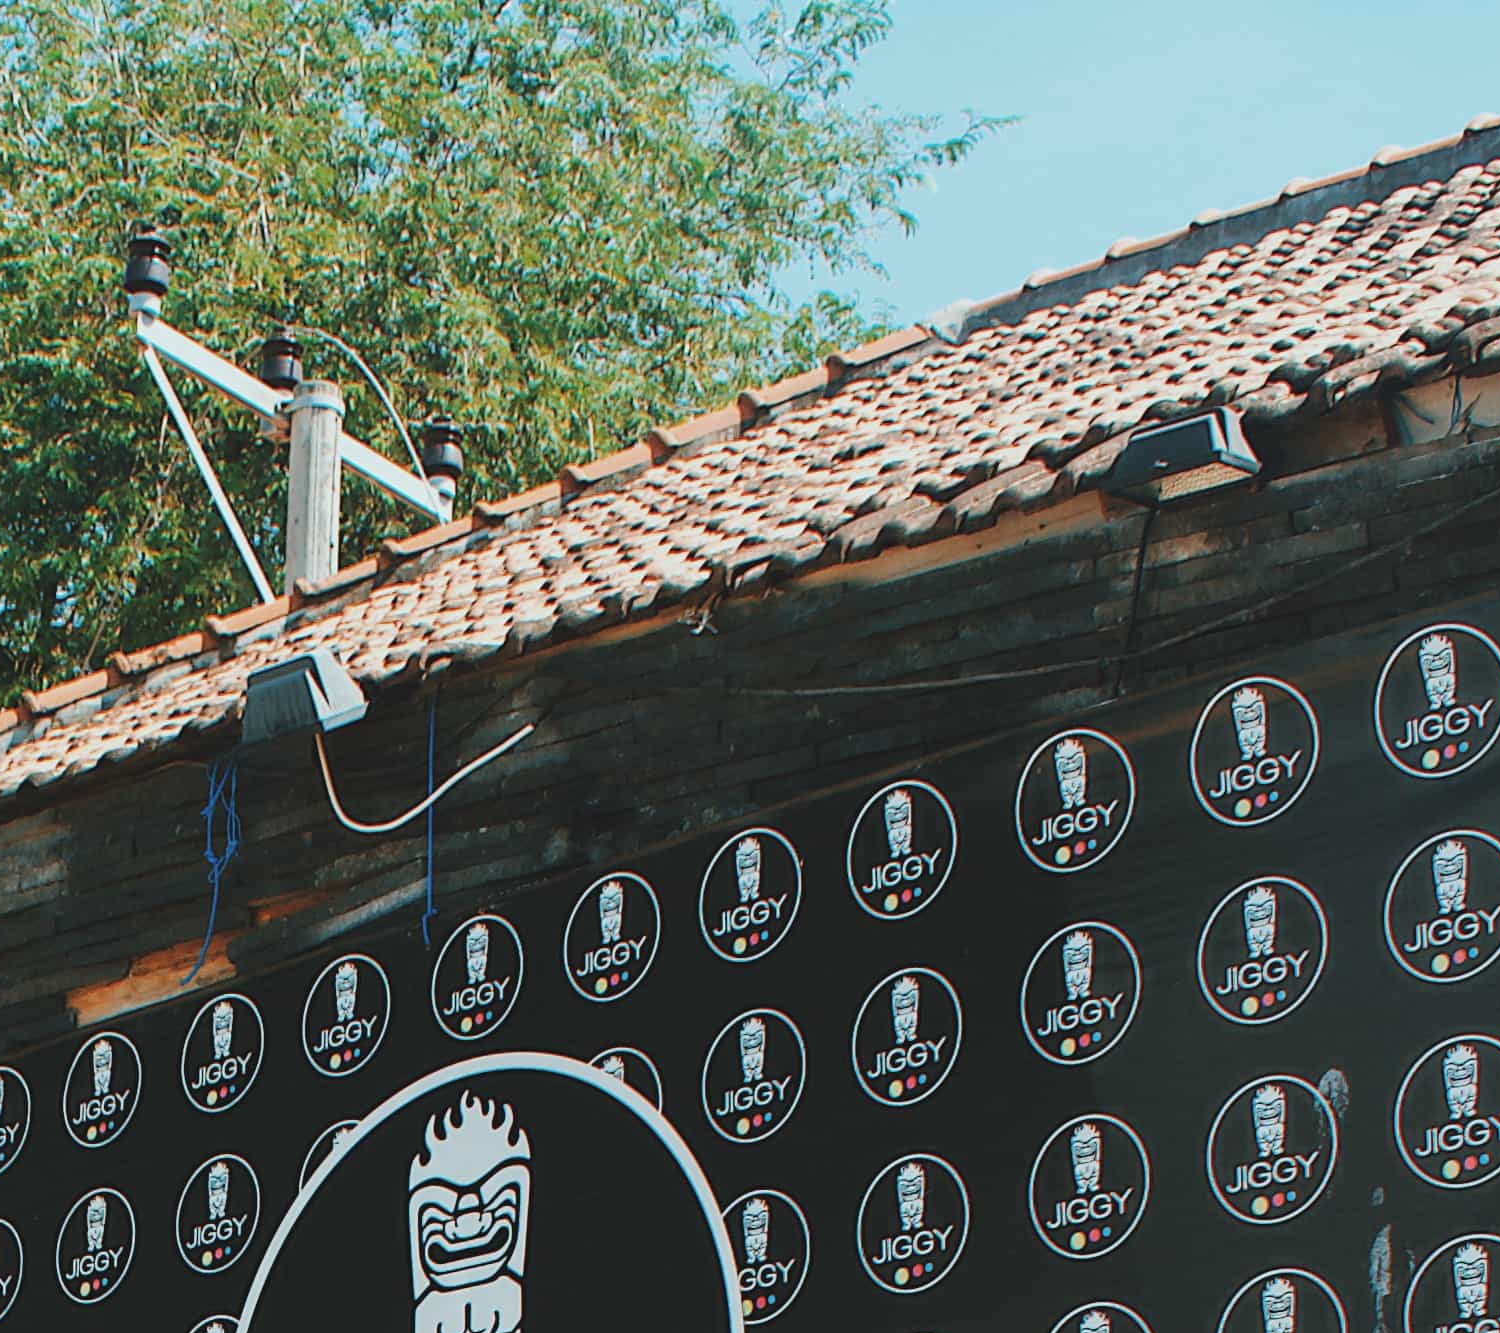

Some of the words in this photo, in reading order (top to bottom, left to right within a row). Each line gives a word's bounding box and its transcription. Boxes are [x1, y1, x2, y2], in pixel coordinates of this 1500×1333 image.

[1396, 699, 1493, 748] JIGGY
[1210, 750, 1302, 798] JIGGY
[1032, 800, 1118, 845] JIGGY
[862, 848, 941, 893] JIGGY
[576, 936, 646, 976] JIGGY
[1216, 950, 1309, 994] JIGGY
[443, 976, 510, 1015] JIGGY
[1038, 993, 1123, 1036] JIGGY
[314, 1015, 377, 1052] JIGGY
[192, 1052, 252, 1089] JIGGY
[867, 1036, 946, 1078] JIGGY
[73, 1089, 130, 1125] JIGGY
[716, 1076, 791, 1116] JIGGY
[186, 1214, 247, 1249] JIGGY
[66, 1247, 123, 1279] JIGGY
